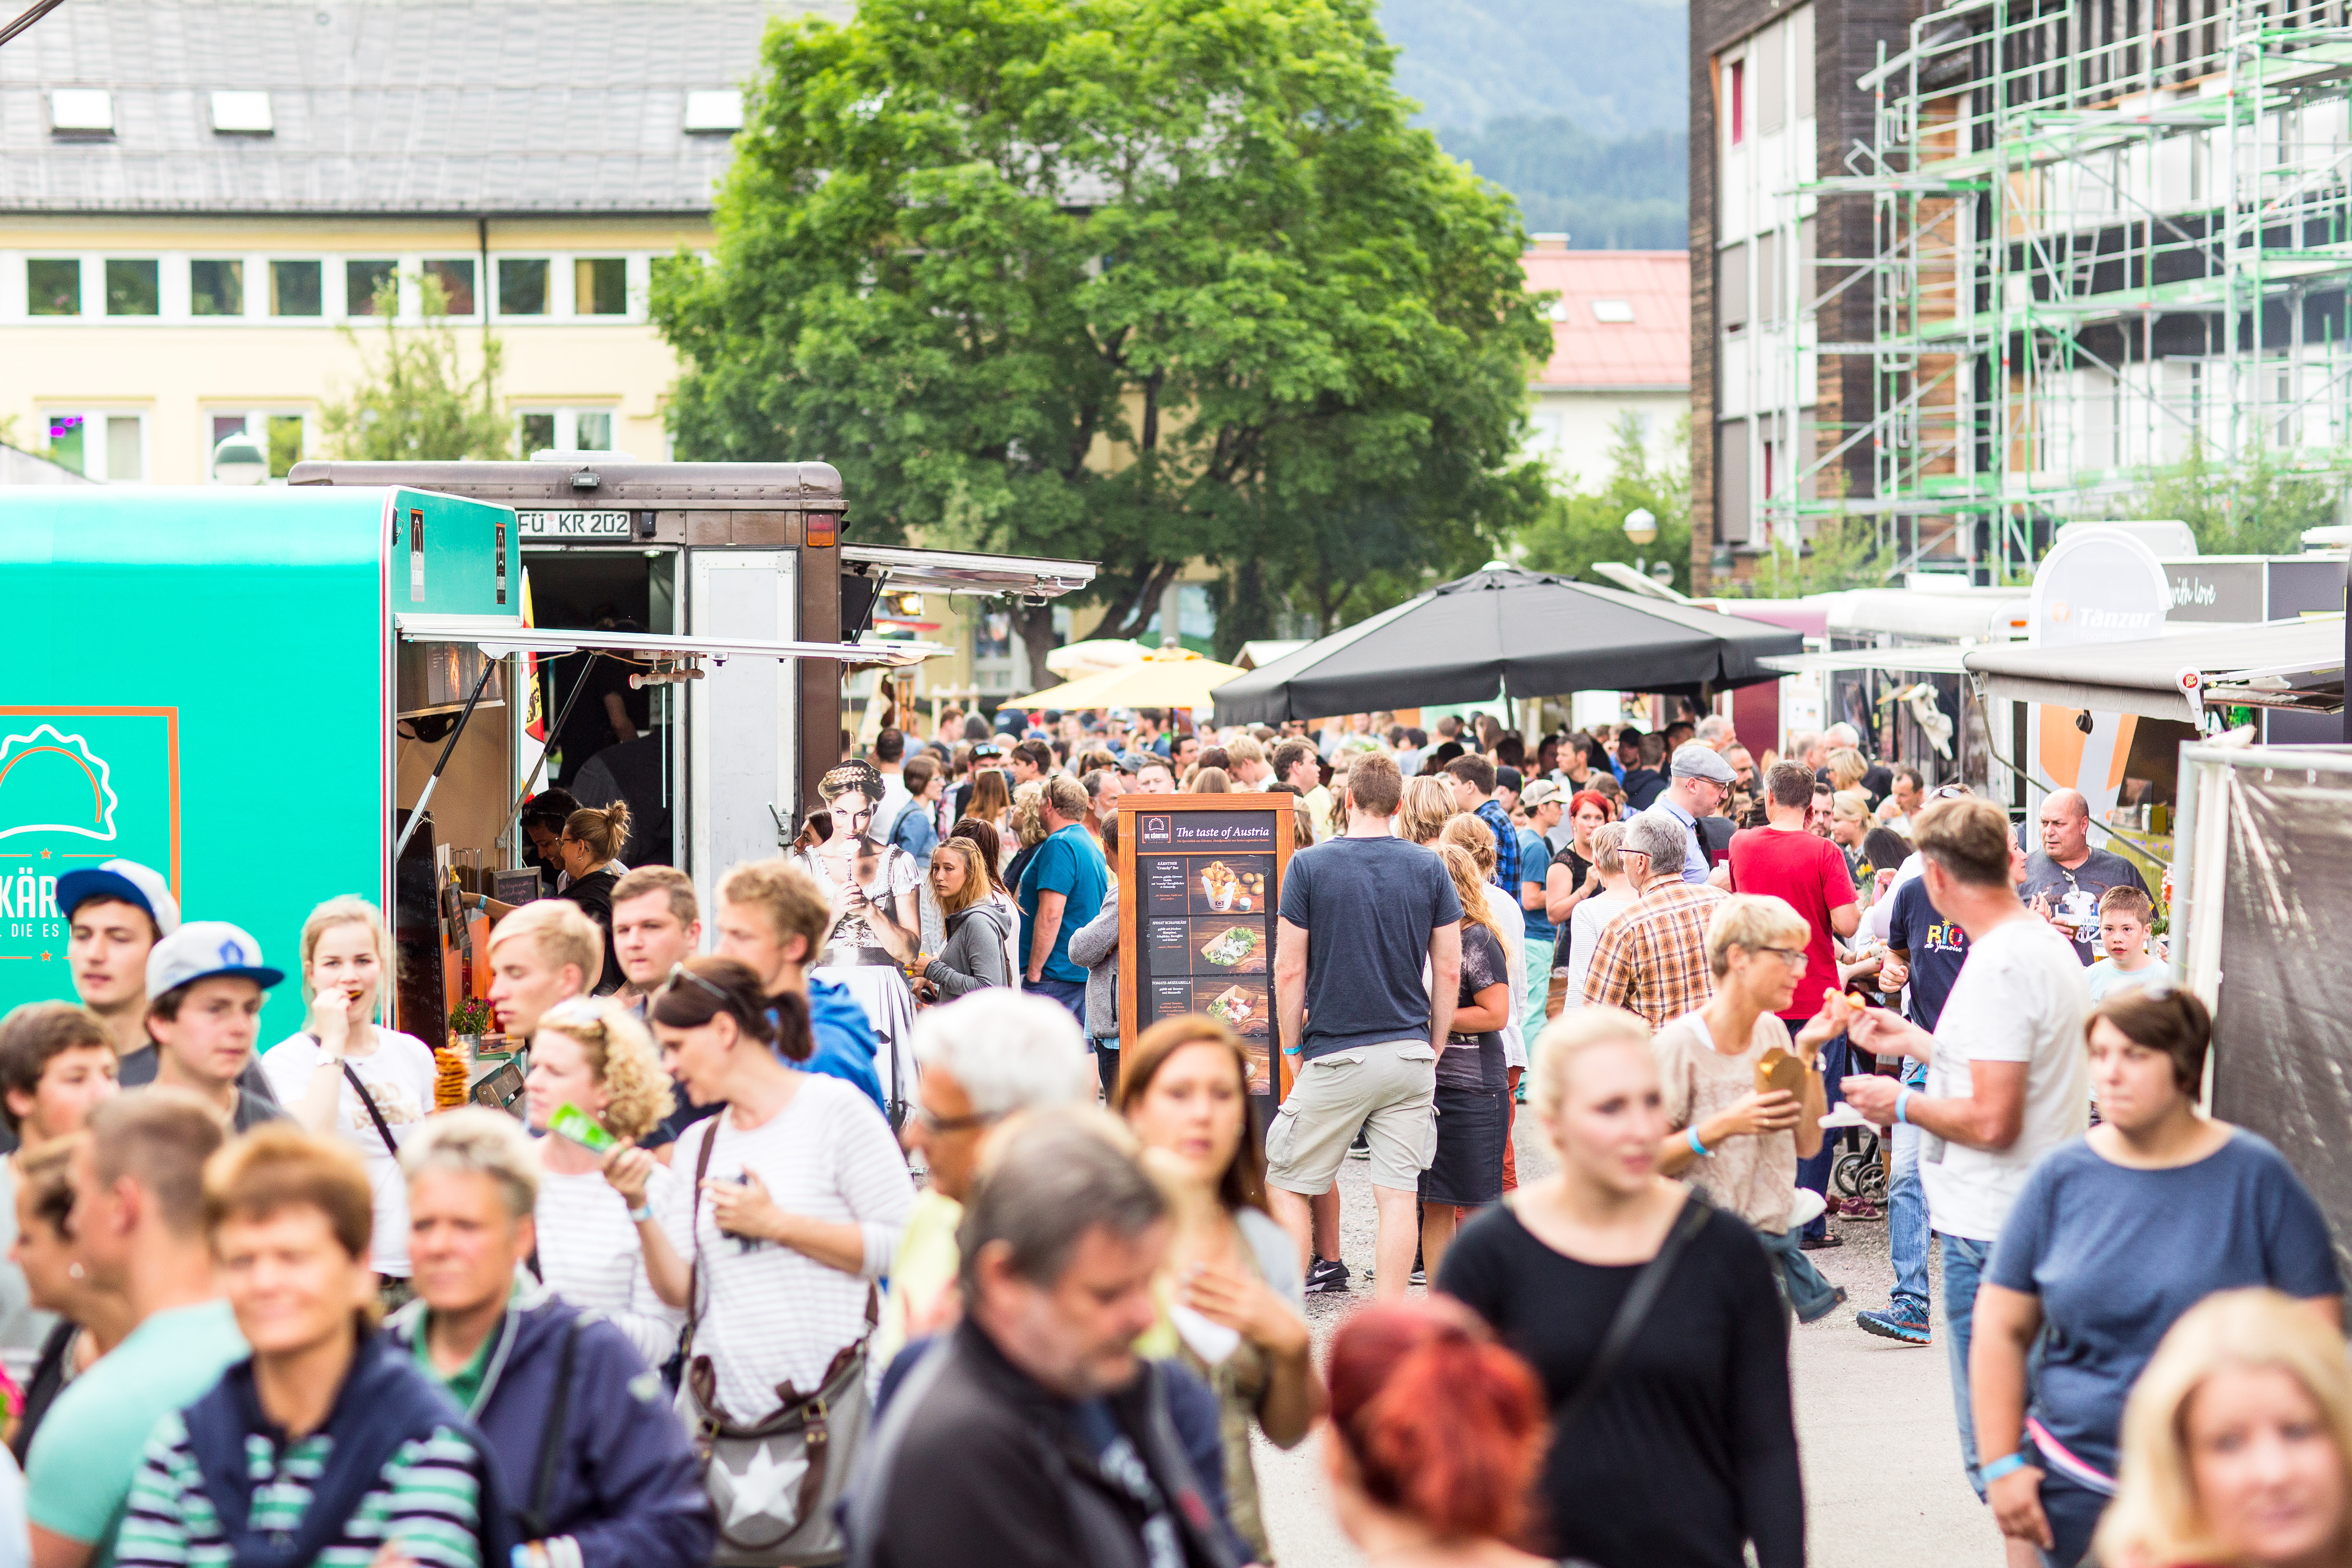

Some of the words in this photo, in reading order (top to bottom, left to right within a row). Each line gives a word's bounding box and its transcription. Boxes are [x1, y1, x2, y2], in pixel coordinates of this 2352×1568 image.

[518, 514, 543, 532] FÜ
[559, 514, 585, 532] KR
[591, 514, 628, 532] 202
[2194, 576, 2217, 606] love
[2080, 608, 2156, 629] Tänzer
[2080, 631, 2134, 642] Foodtrailer
[1176, 827, 1194, 837] The
[1196, 828, 1219, 837] taste
[1221, 826, 1233, 839] of
[1232, 827, 1269, 836] Austria
[0, 867, 68, 918] KÄR
[11, 924, 33, 937] DIE
[42, 924, 59, 937] ES
[1927, 925, 1963, 946] RIO
[1924, 940, 1934, 948] de
[1934, 940, 1962, 953] Janeiro
